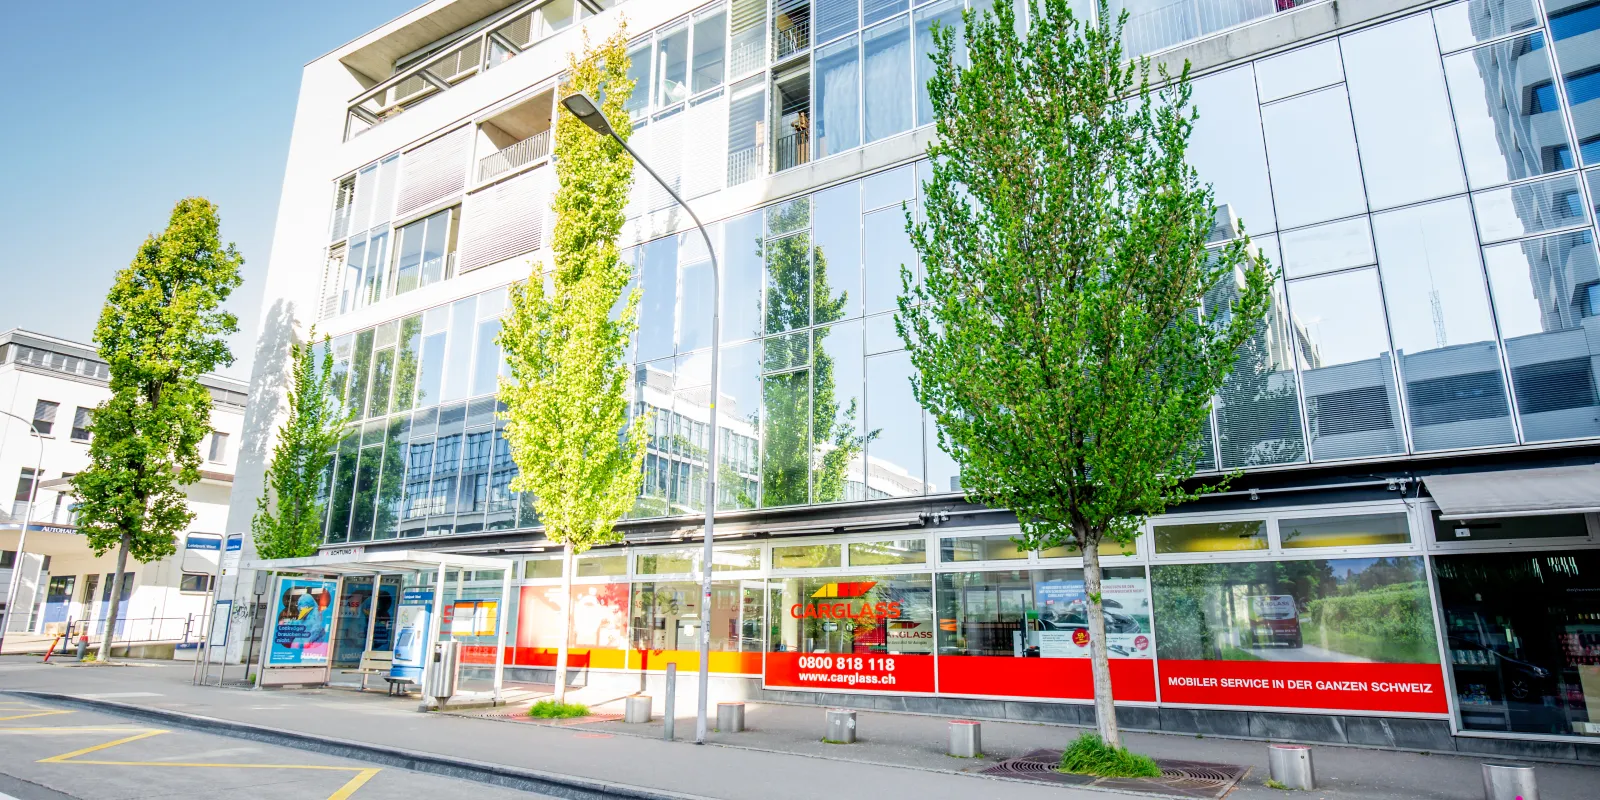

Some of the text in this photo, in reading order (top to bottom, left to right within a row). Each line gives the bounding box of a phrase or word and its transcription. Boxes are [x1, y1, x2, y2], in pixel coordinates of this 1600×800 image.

[790, 601, 902, 619] CARGLASS
[798, 656, 895, 671] 0800 818 118
[798, 672, 896, 685] www.carglass.ch
[1168, 676, 1433, 693] MOBILER SERVICE IN DER GANZEN SCHWEIZ
